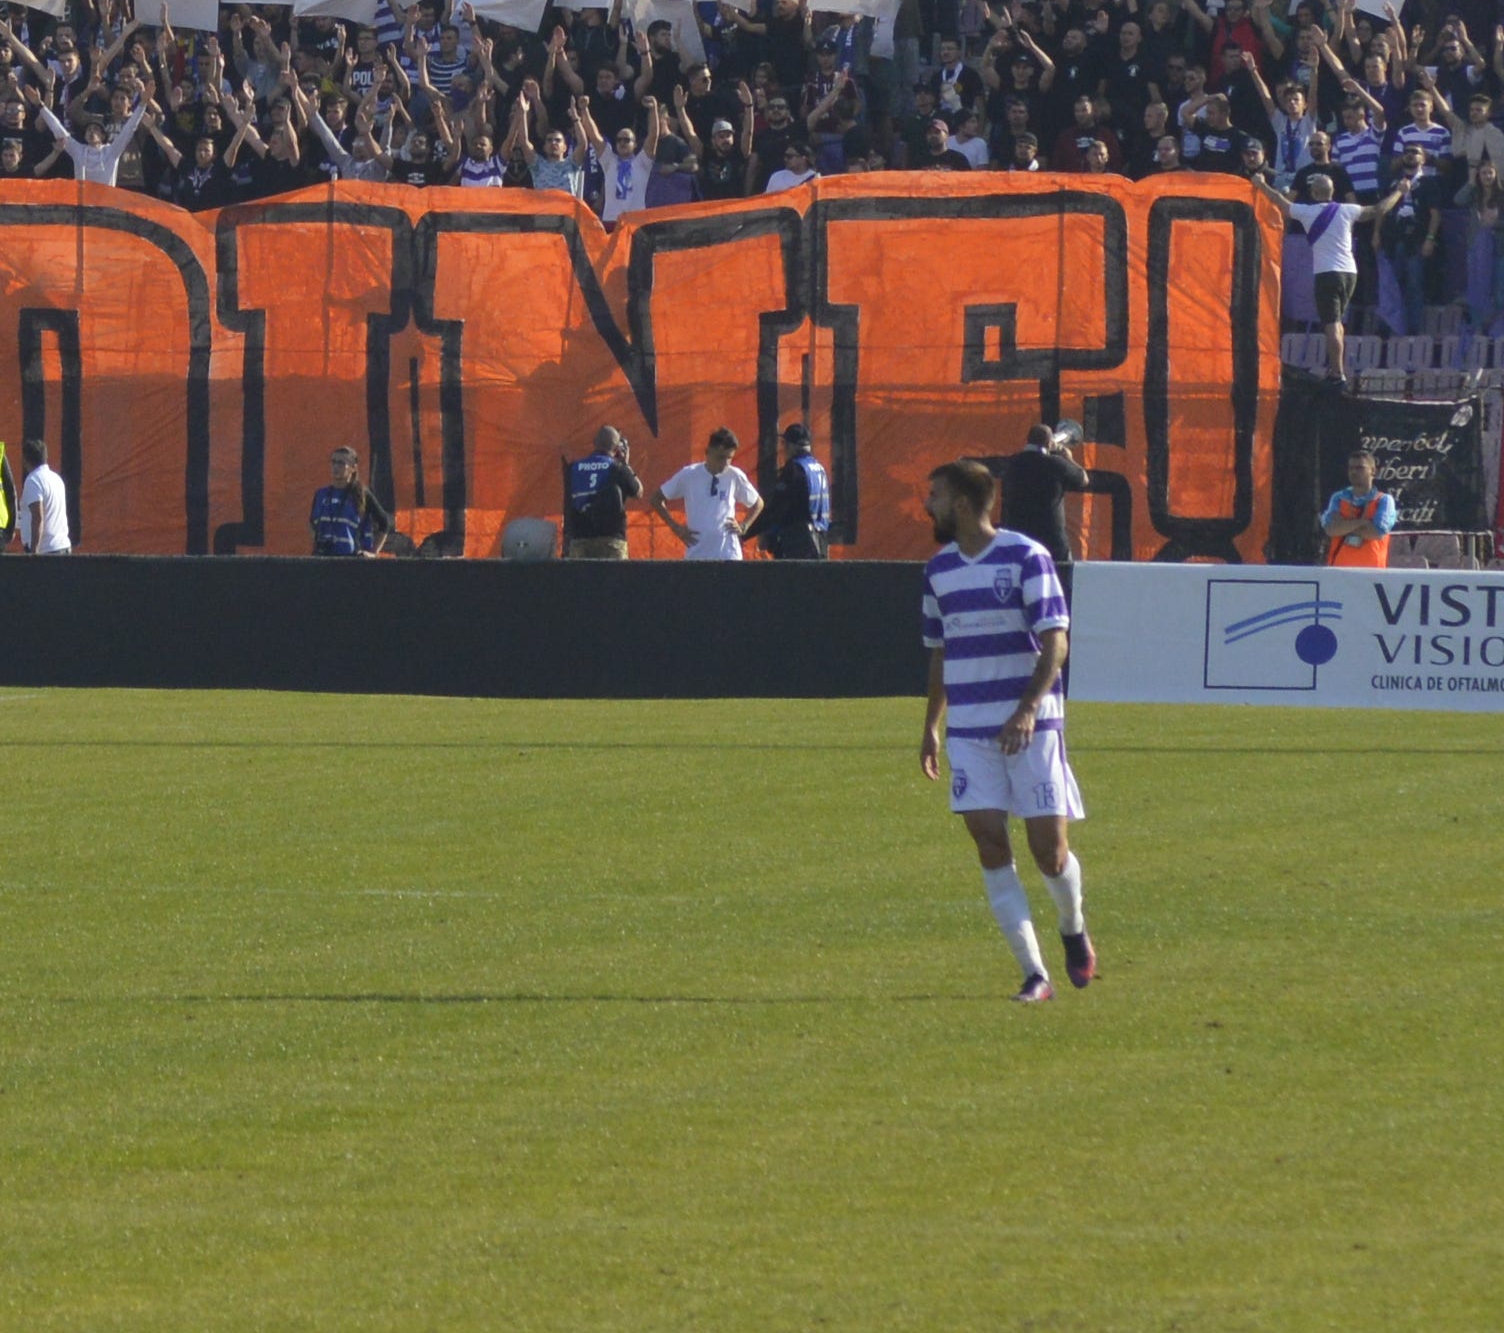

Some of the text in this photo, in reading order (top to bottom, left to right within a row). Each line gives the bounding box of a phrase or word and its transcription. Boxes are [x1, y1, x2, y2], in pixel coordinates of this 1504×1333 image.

[578, 462, 609, 471] PHOTO
[1371, 674, 1422, 691] CLINICA
[1428, 676, 1443, 691] DE
